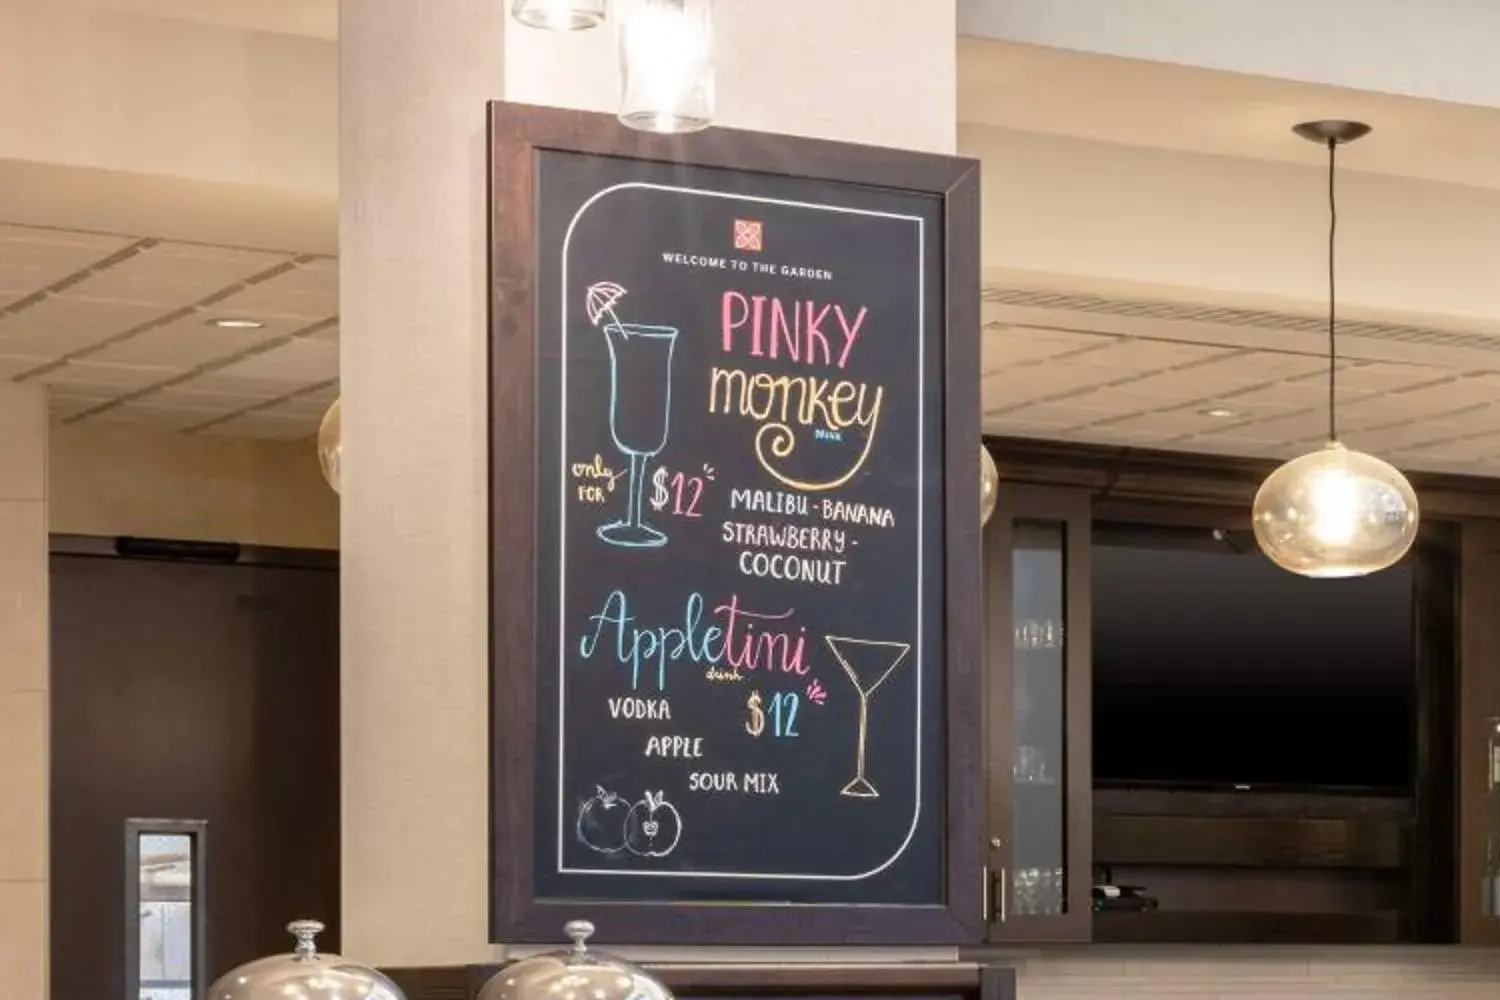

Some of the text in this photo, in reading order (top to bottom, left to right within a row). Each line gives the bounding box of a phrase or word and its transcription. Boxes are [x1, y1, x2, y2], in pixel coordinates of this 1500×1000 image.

[662, 252, 833, 281] WELCOME TO THE GARDEN
[721, 291, 868, 369] PINKY
[708, 366, 885, 490] monkey
[571, 453, 628, 492] only
[577, 485, 606, 503] FOR
[649, 465, 704, 517] $12
[738, 551, 848, 585] COCONUT
[579, 589, 812, 692] Appletini
[608, 697, 672, 721] VODKA
[744, 688, 800, 738] $12
[643, 735, 704, 758] APPLE
[688, 771, 780, 795] SOUR MIX
